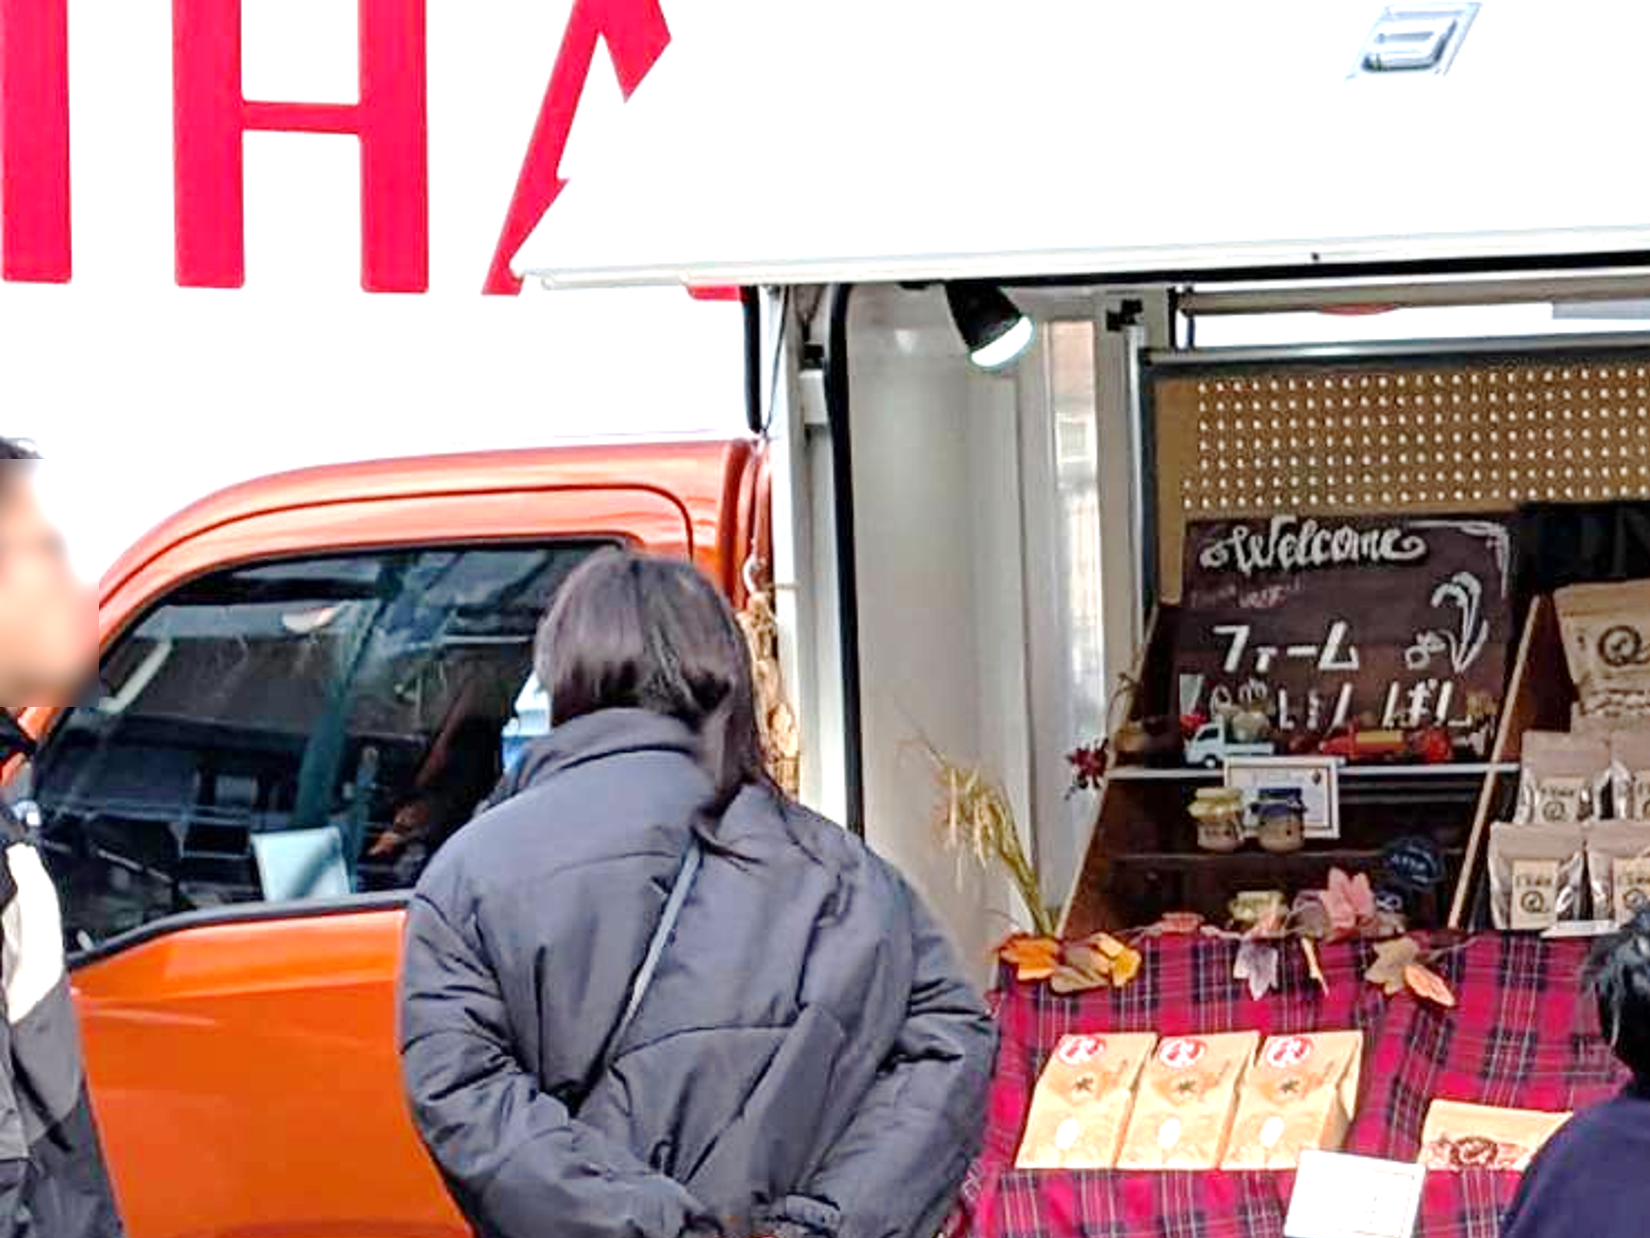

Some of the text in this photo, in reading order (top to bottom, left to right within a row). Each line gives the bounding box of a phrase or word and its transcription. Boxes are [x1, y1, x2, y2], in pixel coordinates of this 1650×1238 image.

[1199, 515, 1427, 577] Welcome
[1212, 620, 1360, 673] ファーム
